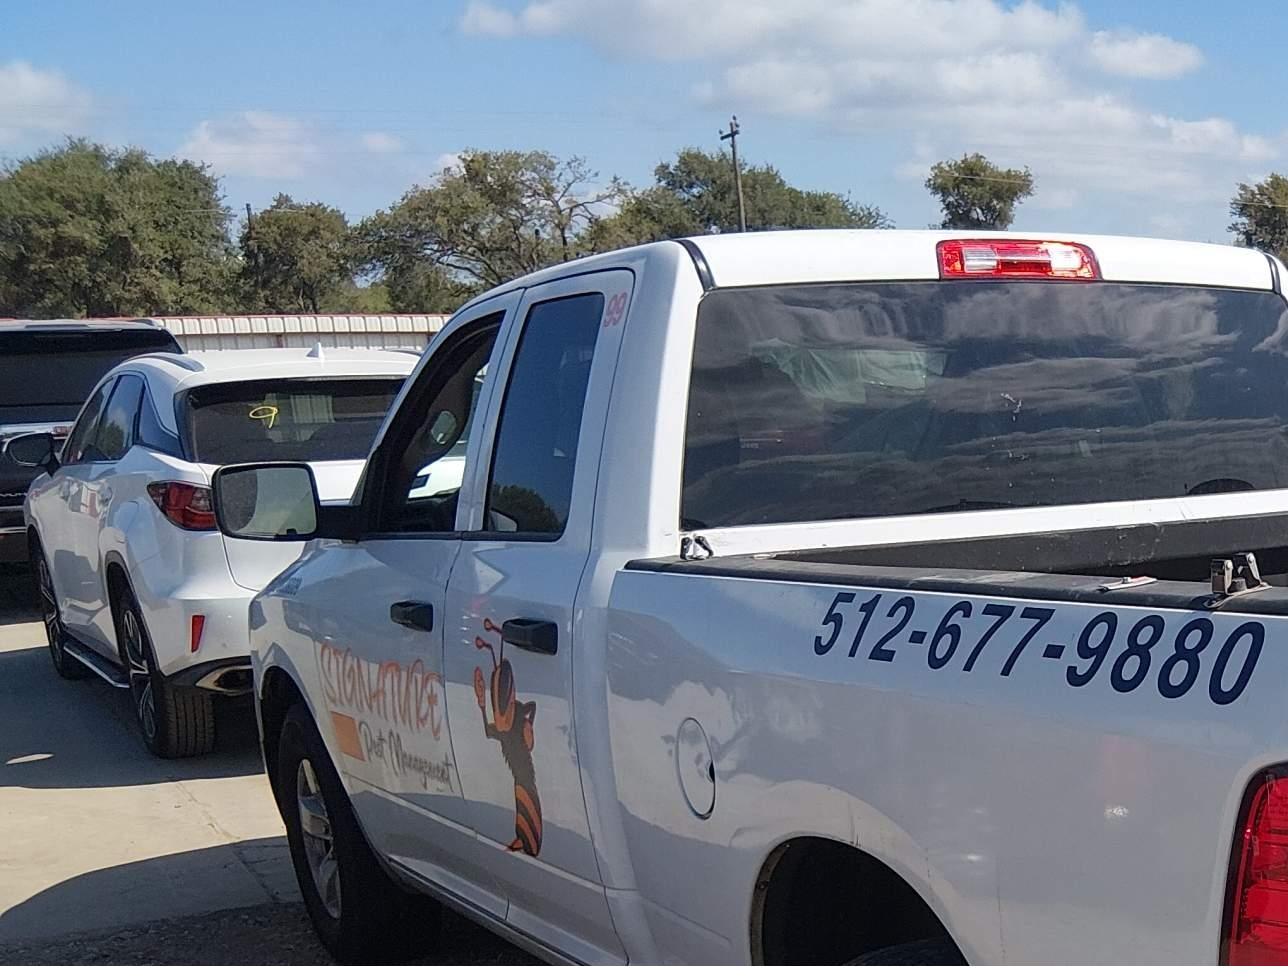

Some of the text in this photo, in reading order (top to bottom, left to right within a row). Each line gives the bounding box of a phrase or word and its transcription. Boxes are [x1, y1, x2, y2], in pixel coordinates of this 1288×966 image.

[249, 405, 278, 429] 9
[320, 643, 442, 741] SIGNATURE
[814, 591, 1265, 705] 512-677-9880
